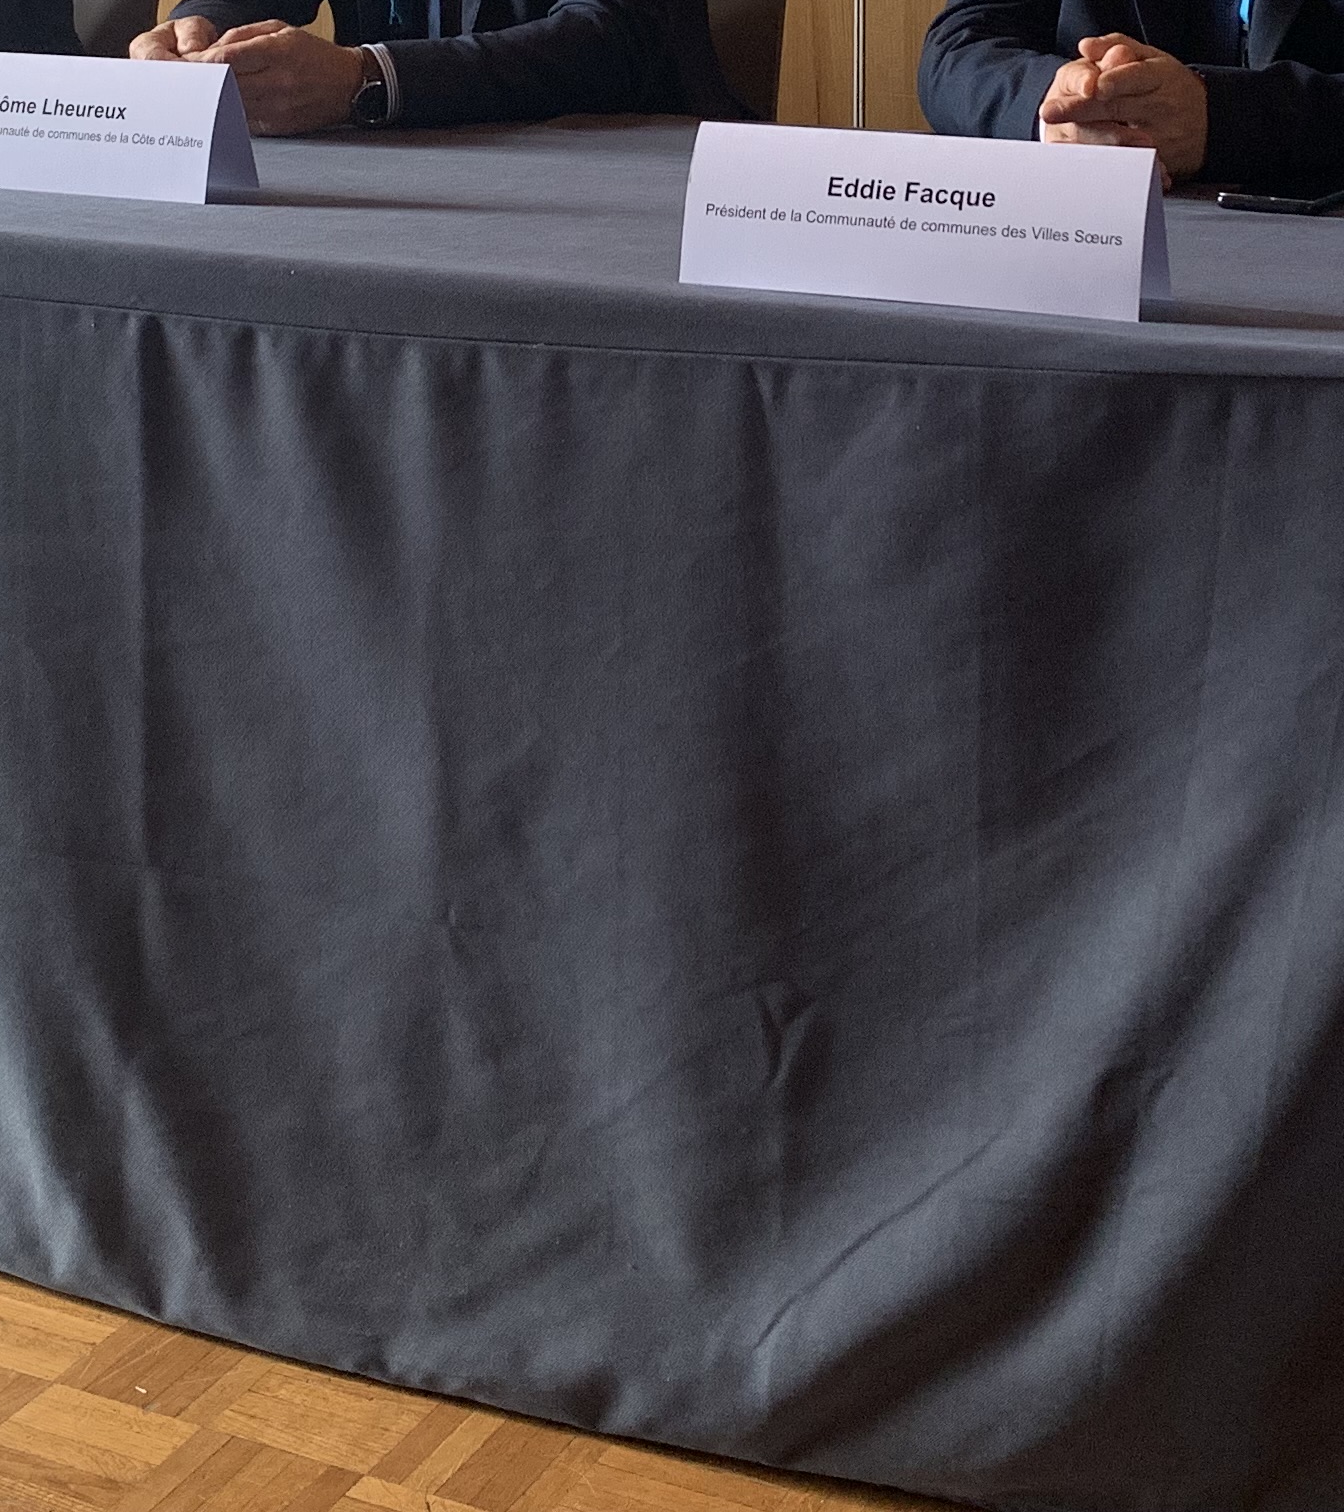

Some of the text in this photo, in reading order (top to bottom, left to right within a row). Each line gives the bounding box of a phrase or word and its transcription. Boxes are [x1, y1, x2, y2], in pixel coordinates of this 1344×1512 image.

[43, 98, 127, 121] Lheureux
[32, 127, 45, 138] de
[48, 130, 102, 143] communes
[104, 132, 117, 144] de
[120, 132, 129, 144] la
[132, 133, 156, 146] Côte
[827, 176, 996, 209] Eddie Facque
[705, 203, 1123, 246] Président de la Communauté de communes des Villes Sœurs
